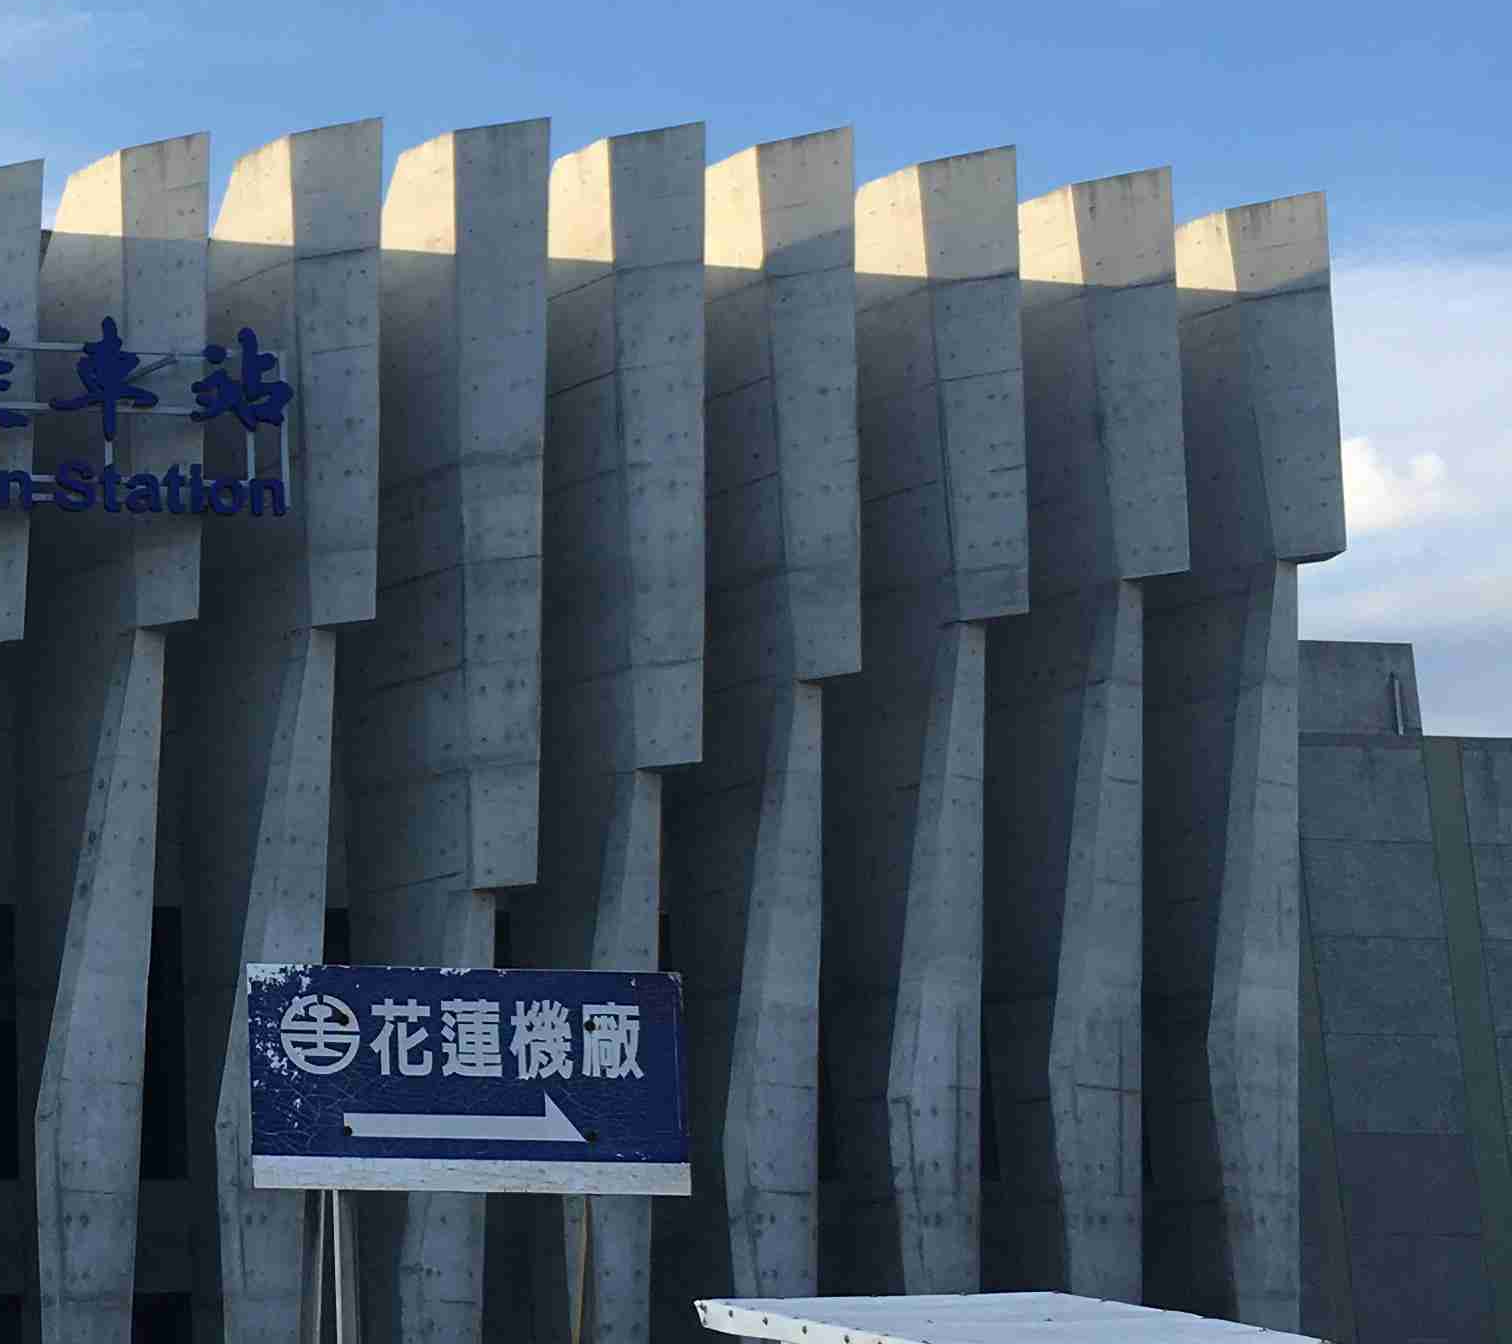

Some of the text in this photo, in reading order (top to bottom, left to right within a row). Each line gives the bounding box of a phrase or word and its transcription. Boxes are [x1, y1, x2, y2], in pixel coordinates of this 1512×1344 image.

[55, 460, 288, 517] Station
[369, 998, 645, 1081] 花蓮機廠
